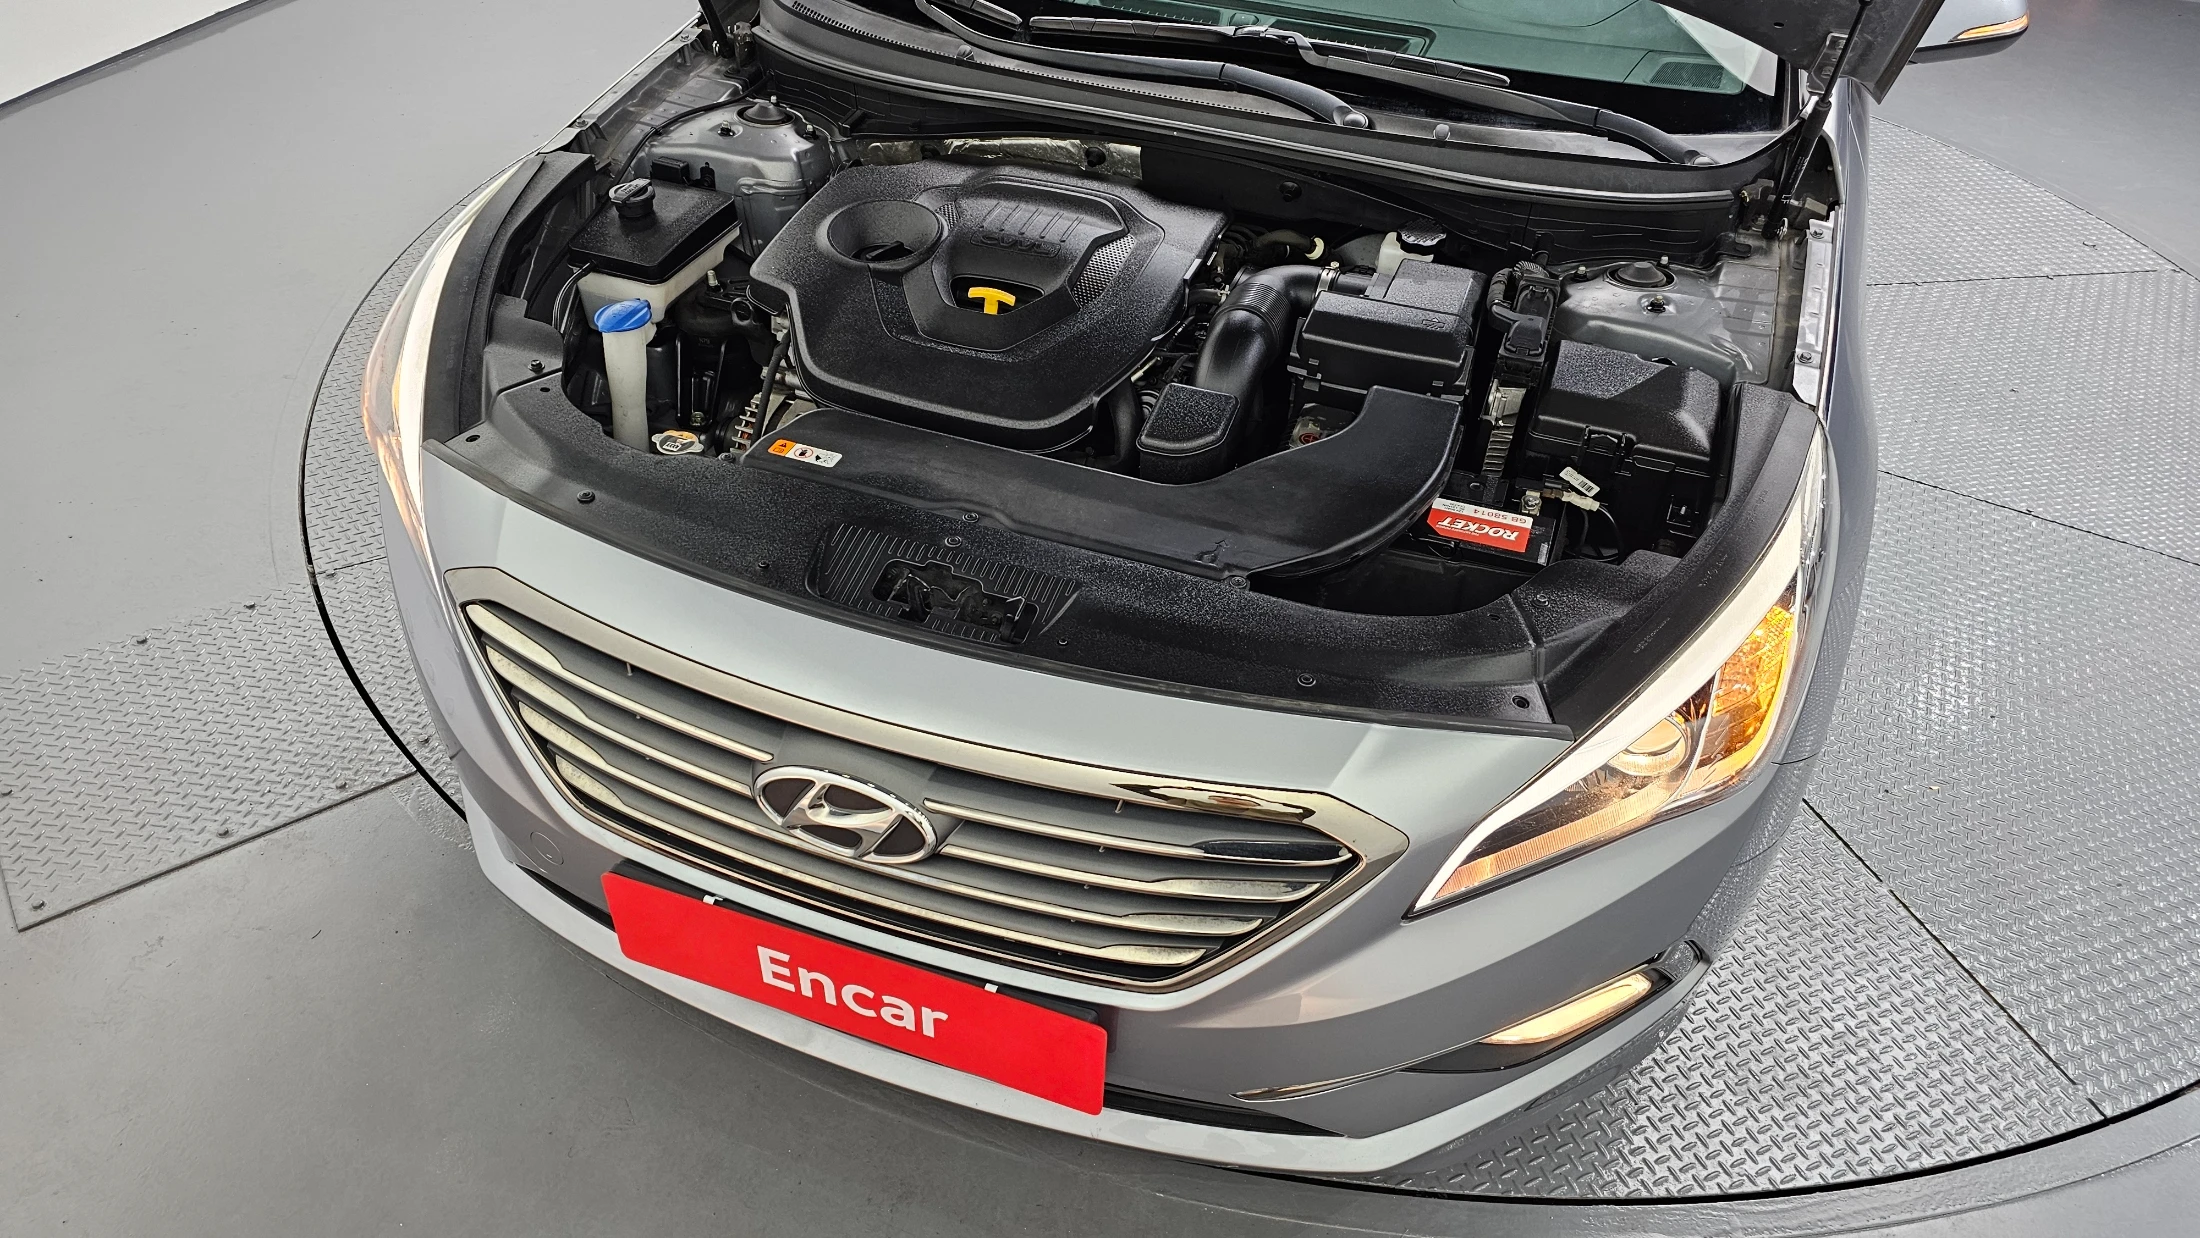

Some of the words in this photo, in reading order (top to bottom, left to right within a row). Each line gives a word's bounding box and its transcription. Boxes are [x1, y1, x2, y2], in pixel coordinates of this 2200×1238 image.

[1437, 516, 1519, 541] ROCKET
[1511, 515, 1528, 525] GB
[756, 945, 949, 1039] Encar
